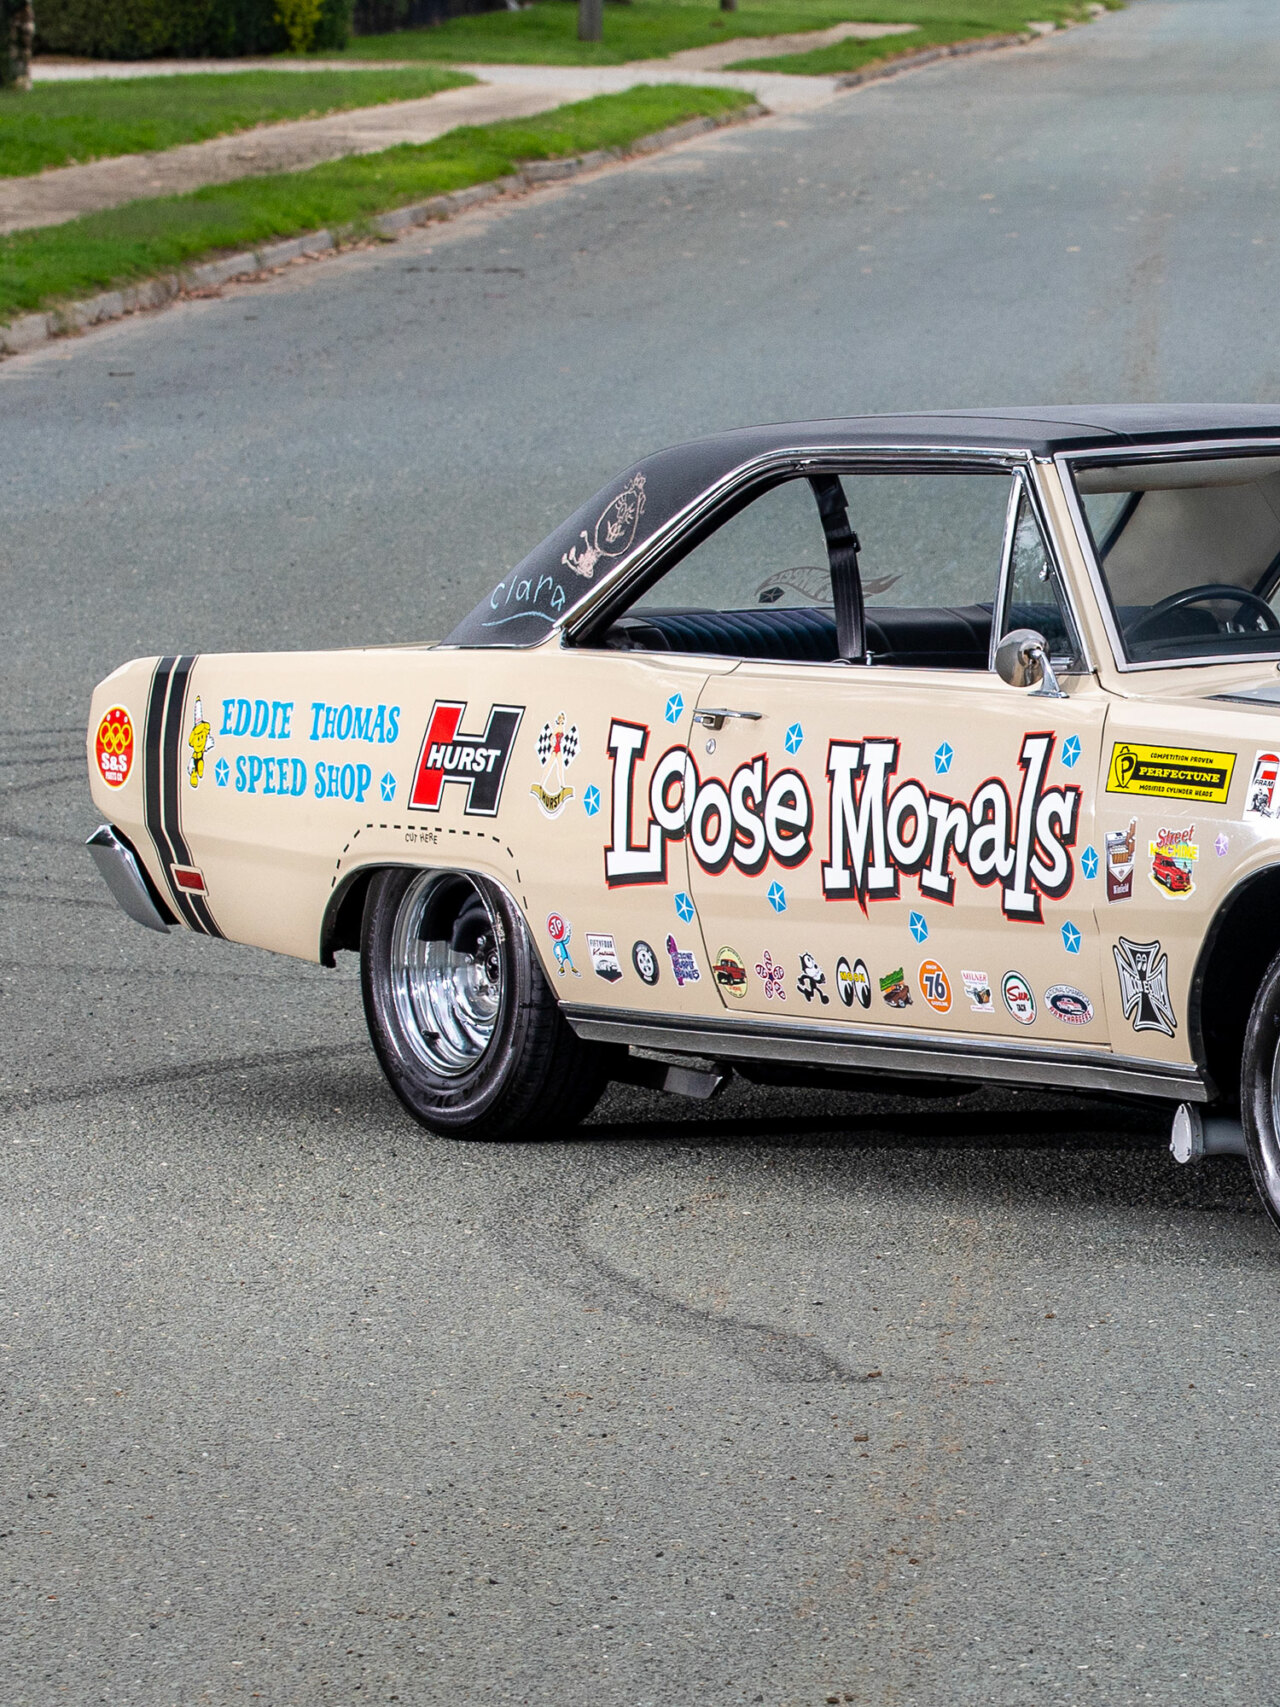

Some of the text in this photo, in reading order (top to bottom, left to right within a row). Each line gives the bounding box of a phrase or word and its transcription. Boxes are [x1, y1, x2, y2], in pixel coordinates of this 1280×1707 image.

[219, 698, 401, 744] EDDIE THOMAS
[101, 752, 127, 772] S&S
[426, 742, 502, 773] HURST
[1150, 752, 1213, 764] COMPETITION PROVEN
[235, 756, 372, 803] SPEED SHOP
[1138, 767, 1220, 783] PERFECTUNE
[1254, 779, 1274, 787] FRAM
[1139, 785, 1213, 797] MODIFIED CYLINDER HEADS
[541, 793, 561, 809] HURST
[604, 718, 1082, 924] Loose Morals
[405, 832, 437, 844] CUT HERE
[1156, 825, 1194, 848] Street
[550, 918, 562, 936] STP
[840, 971, 866, 983] MOON
[963, 972, 987, 981] MILNER
[923, 971, 947, 1000] 76
